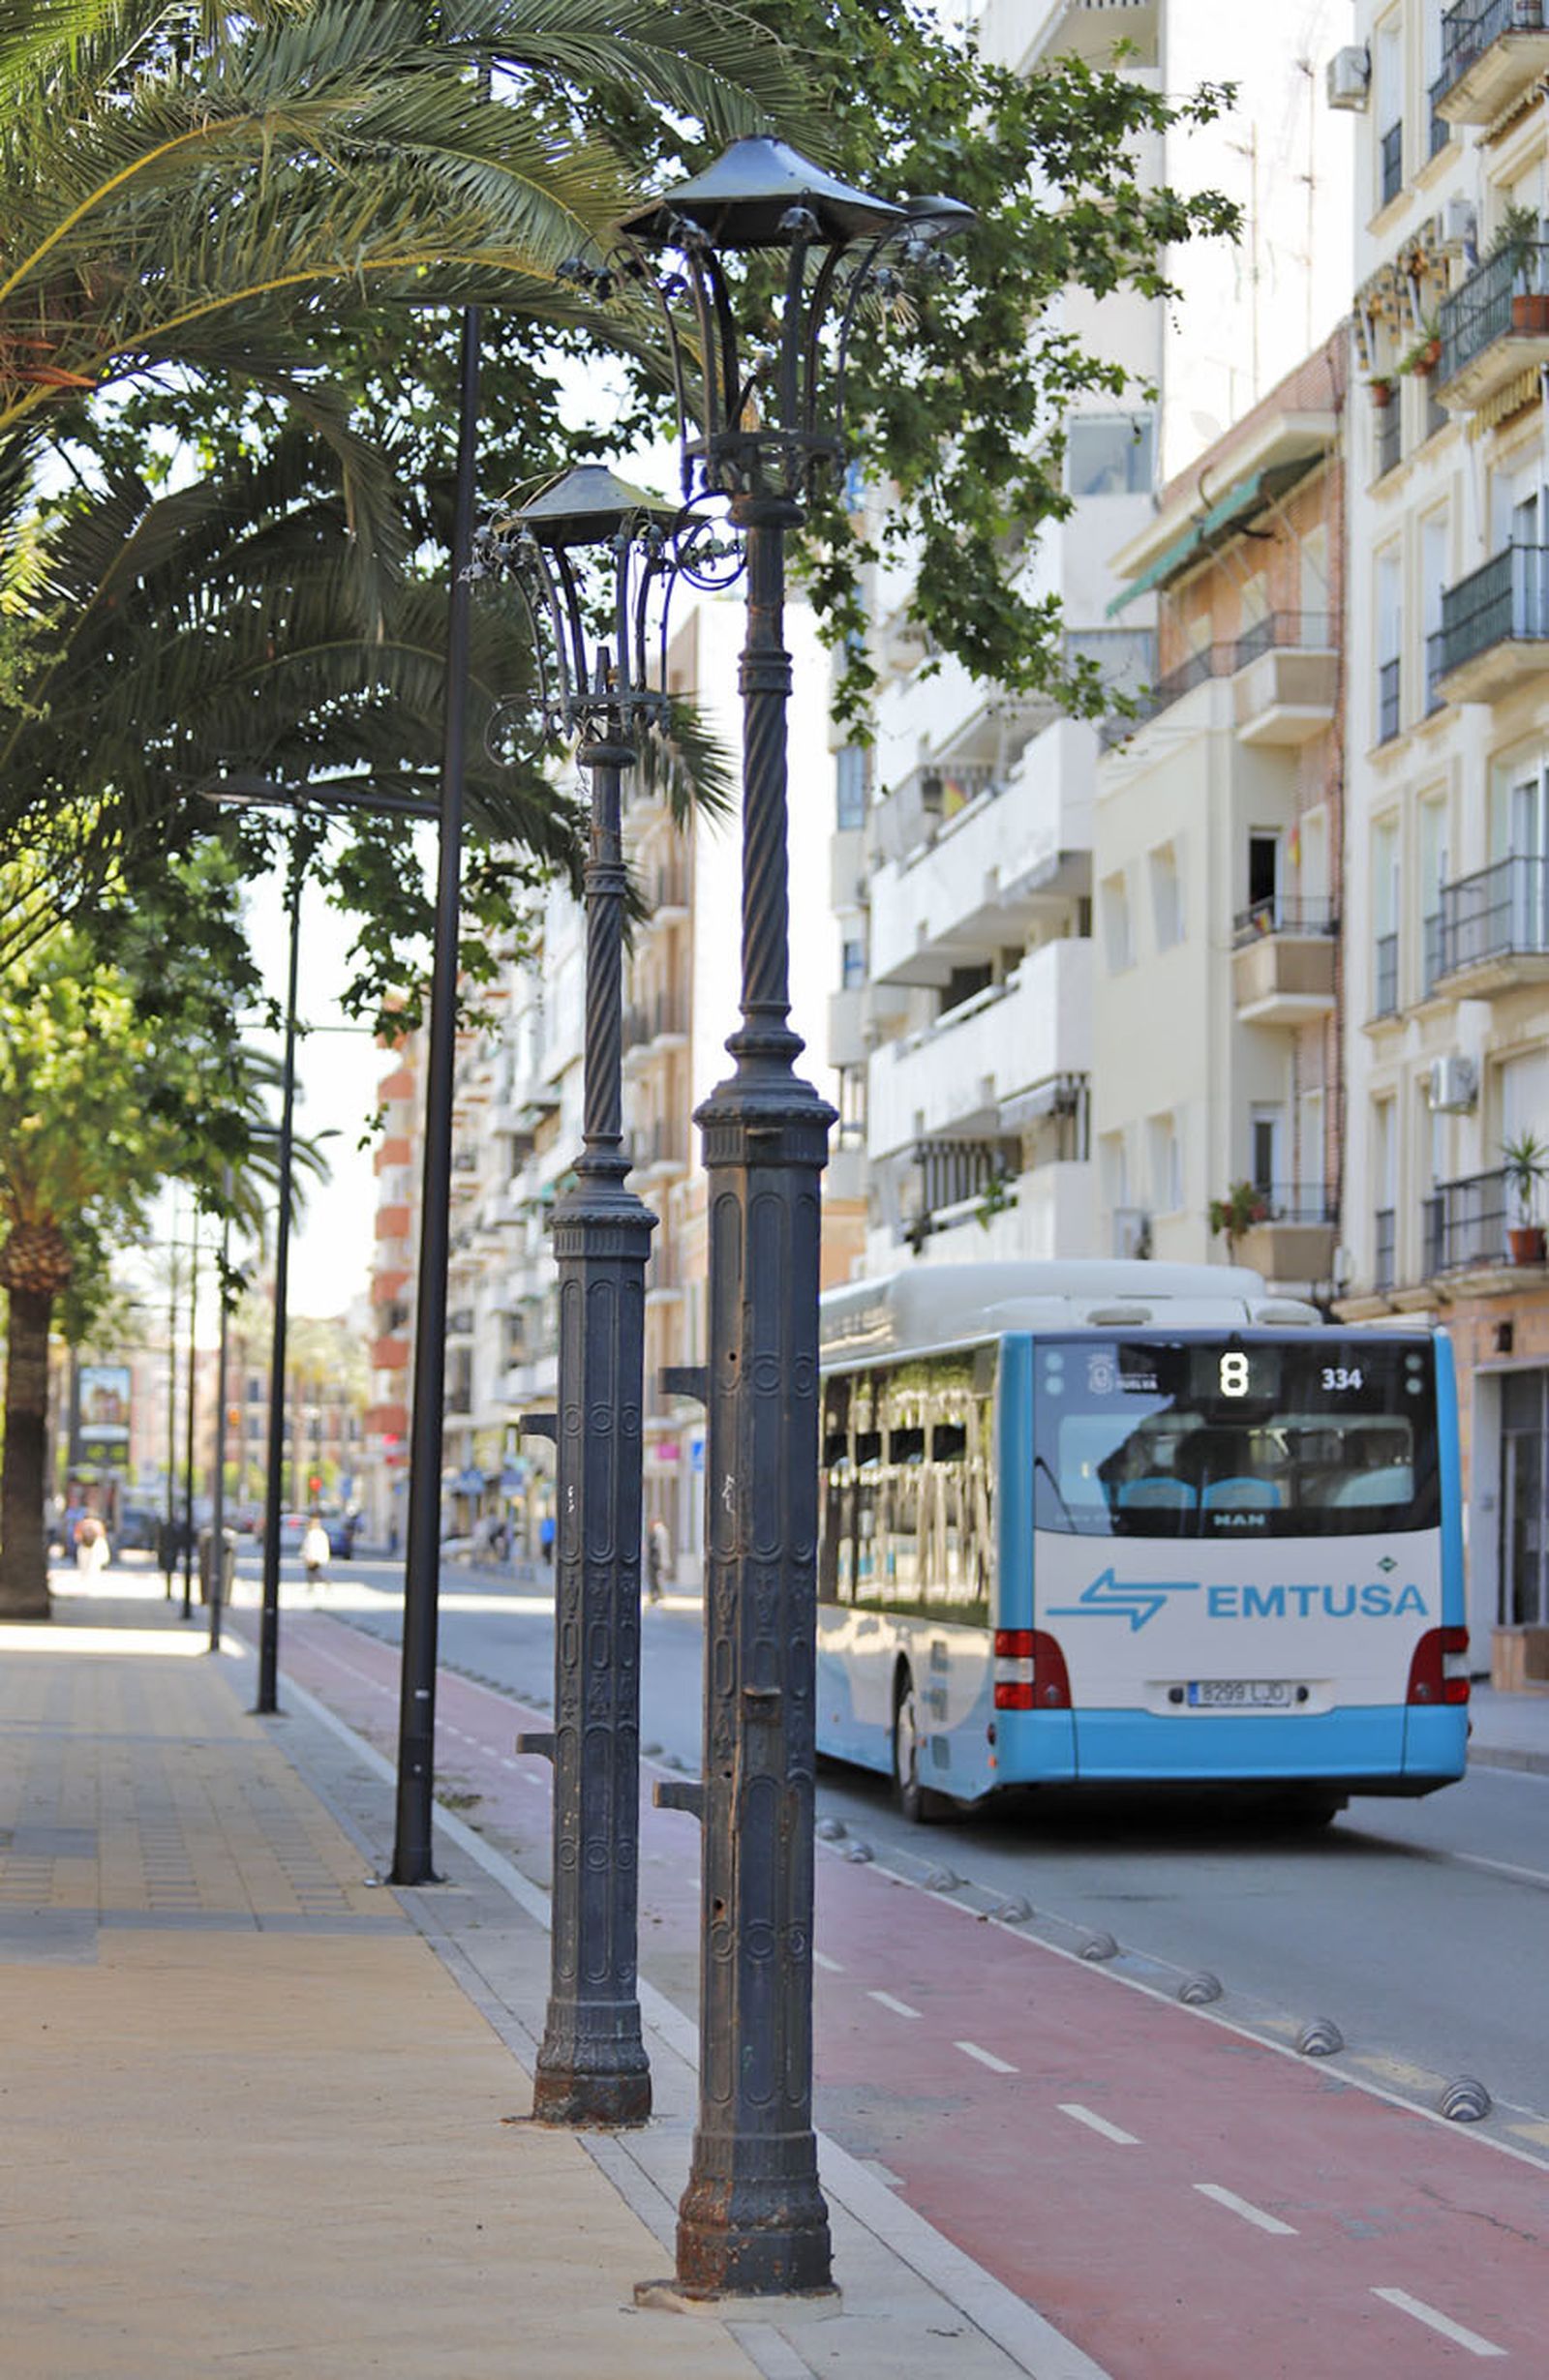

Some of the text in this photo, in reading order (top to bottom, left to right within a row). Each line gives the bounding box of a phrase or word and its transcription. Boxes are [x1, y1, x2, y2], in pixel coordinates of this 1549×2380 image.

[1220, 1351, 1249, 1397] 8
[1321, 1368, 1363, 1390] 334
[1213, 1514, 1265, 1525] MAN
[1207, 1584, 1430, 1617] EMTUSA
